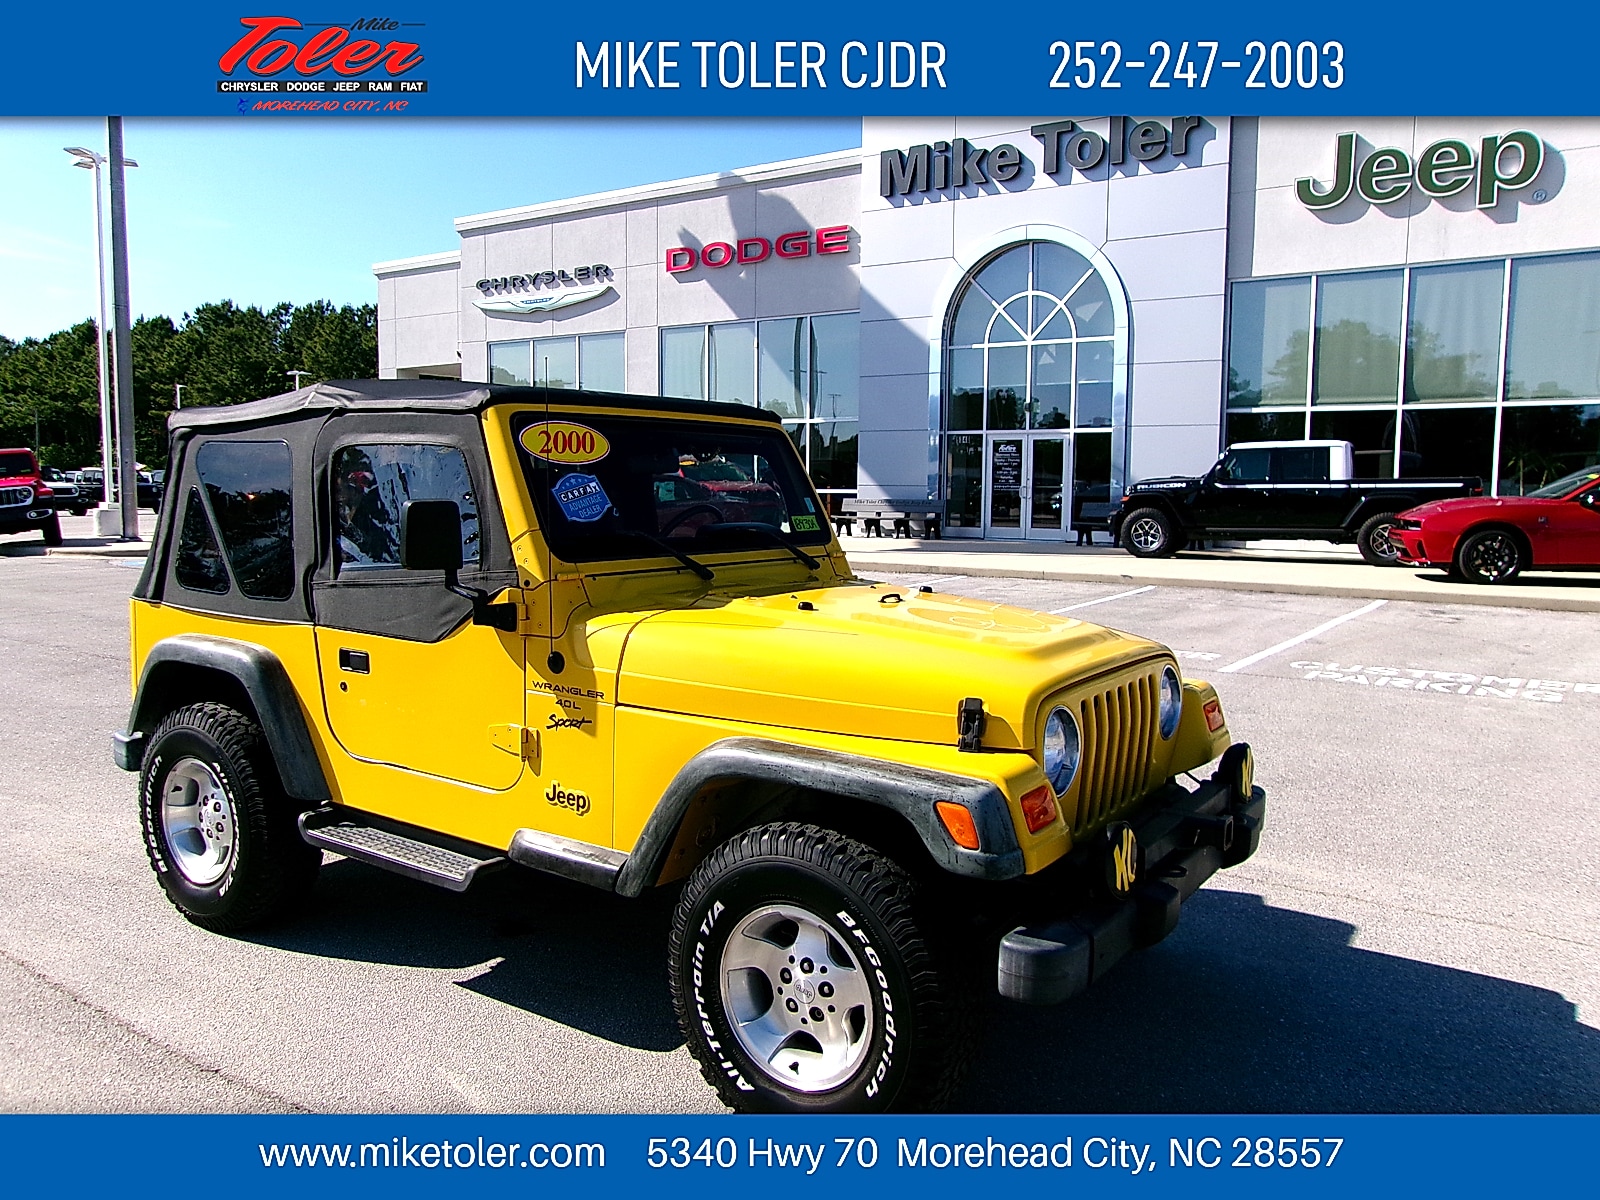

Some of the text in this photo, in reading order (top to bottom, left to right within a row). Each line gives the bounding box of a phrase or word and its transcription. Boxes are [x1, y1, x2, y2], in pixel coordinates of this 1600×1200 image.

[880, 115, 1199, 197] Mike Toler
[1294, 128, 1547, 210] Jeep
[665, 225, 850, 274] DODGE
[475, 263, 611, 292] CHRYSLER
[537, 430, 596, 454] 2000
[560, 483, 600, 502] CARFAX
[568, 494, 603, 512] ADVANTAGE
[578, 505, 603, 518] DEALER
[531, 680, 605, 700] WRANGLER
[1303, 670, 1564, 702] PARKING
[545, 713, 593, 732] Sport
[545, 783, 589, 814] Jeep
[691, 900, 756, 1092] All-Terrain T/A
[836, 910, 898, 1098] BFGoodrich
